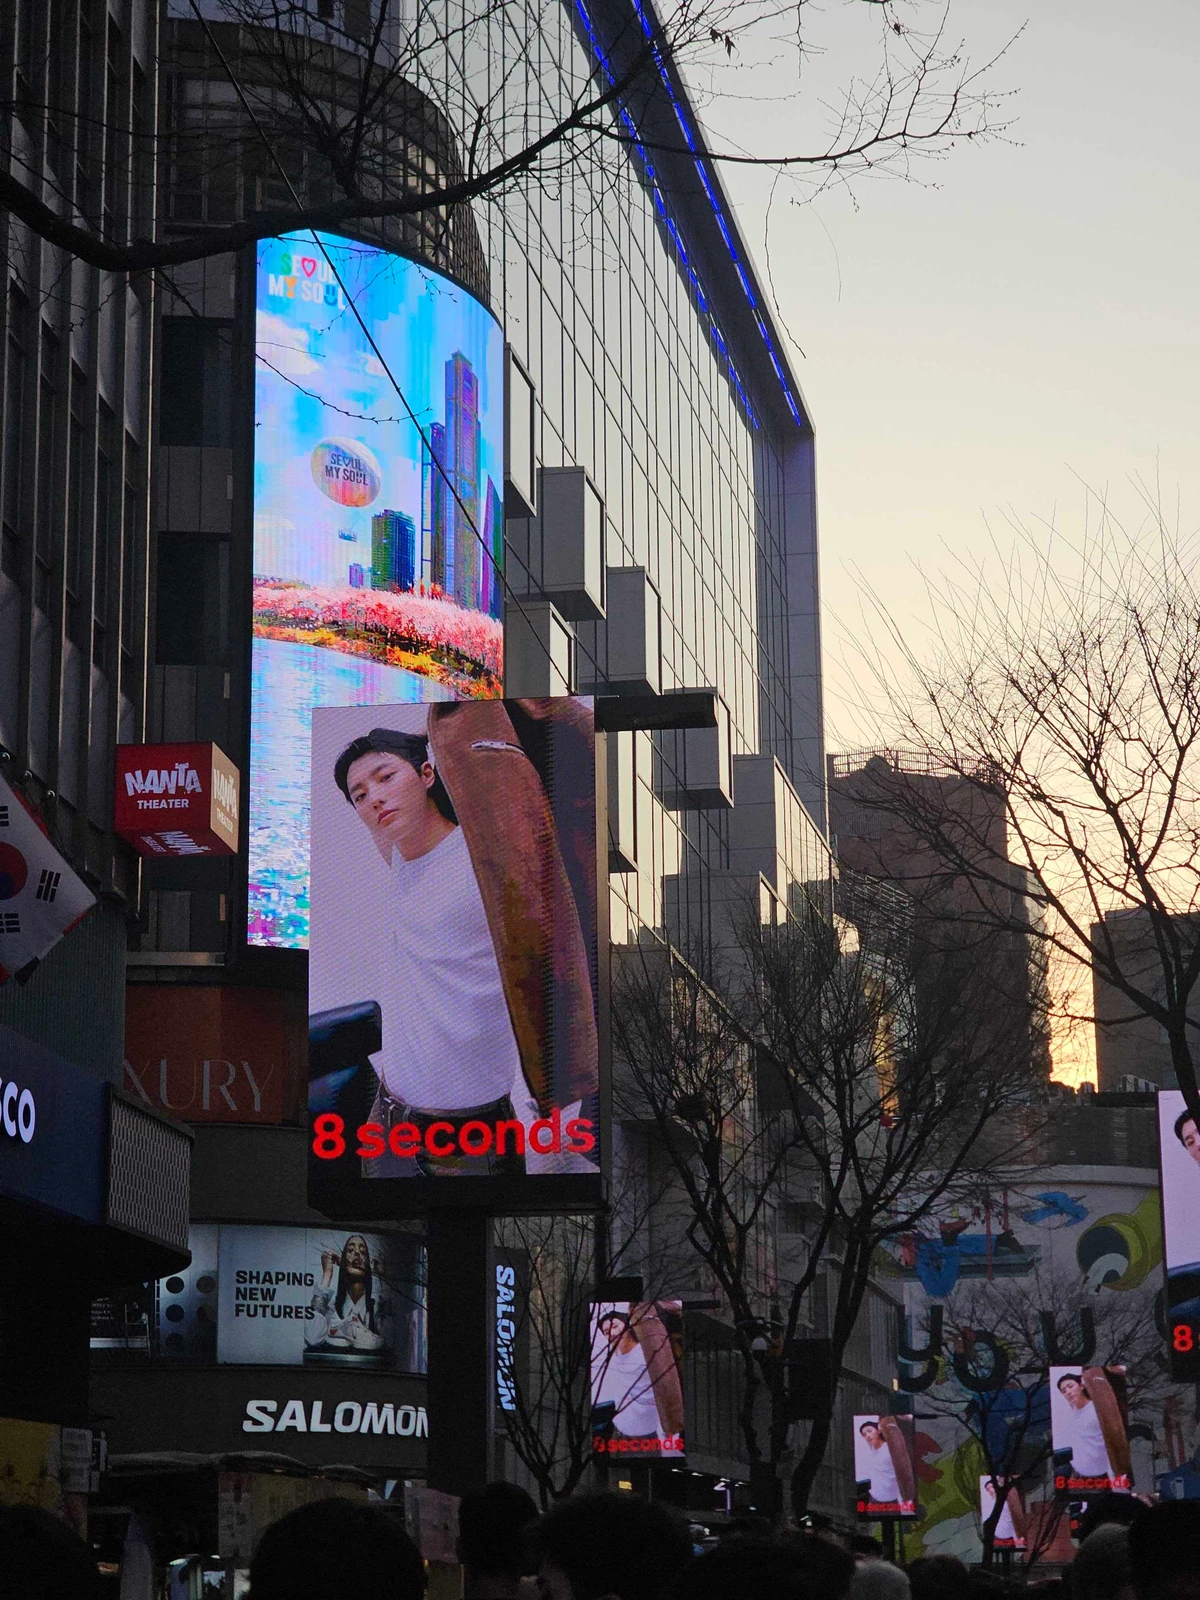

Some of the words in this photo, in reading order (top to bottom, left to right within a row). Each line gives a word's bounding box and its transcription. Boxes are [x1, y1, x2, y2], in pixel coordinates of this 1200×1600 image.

[301, 281, 346, 310] SOUL
[325, 465, 341, 479] MY
[342, 468, 369, 486] SOUL
[124, 762, 202, 796] NANTA
[137, 799, 189, 810] THEATER
[0, 1076, 36, 1143] CO
[311, 1112, 347, 1160] 8
[356, 1106, 597, 1158] seconds
[235, 1270, 314, 1287] SHAPING
[235, 1287, 277, 1301] NEW
[235, 1303, 315, 1320] FUTURES
[1173, 1324, 1194, 1353] 8
[607, 1432, 685, 1453] seconds
[1055, 1475, 1067, 1490] 8
[1067, 1473, 1132, 1490] seconds
